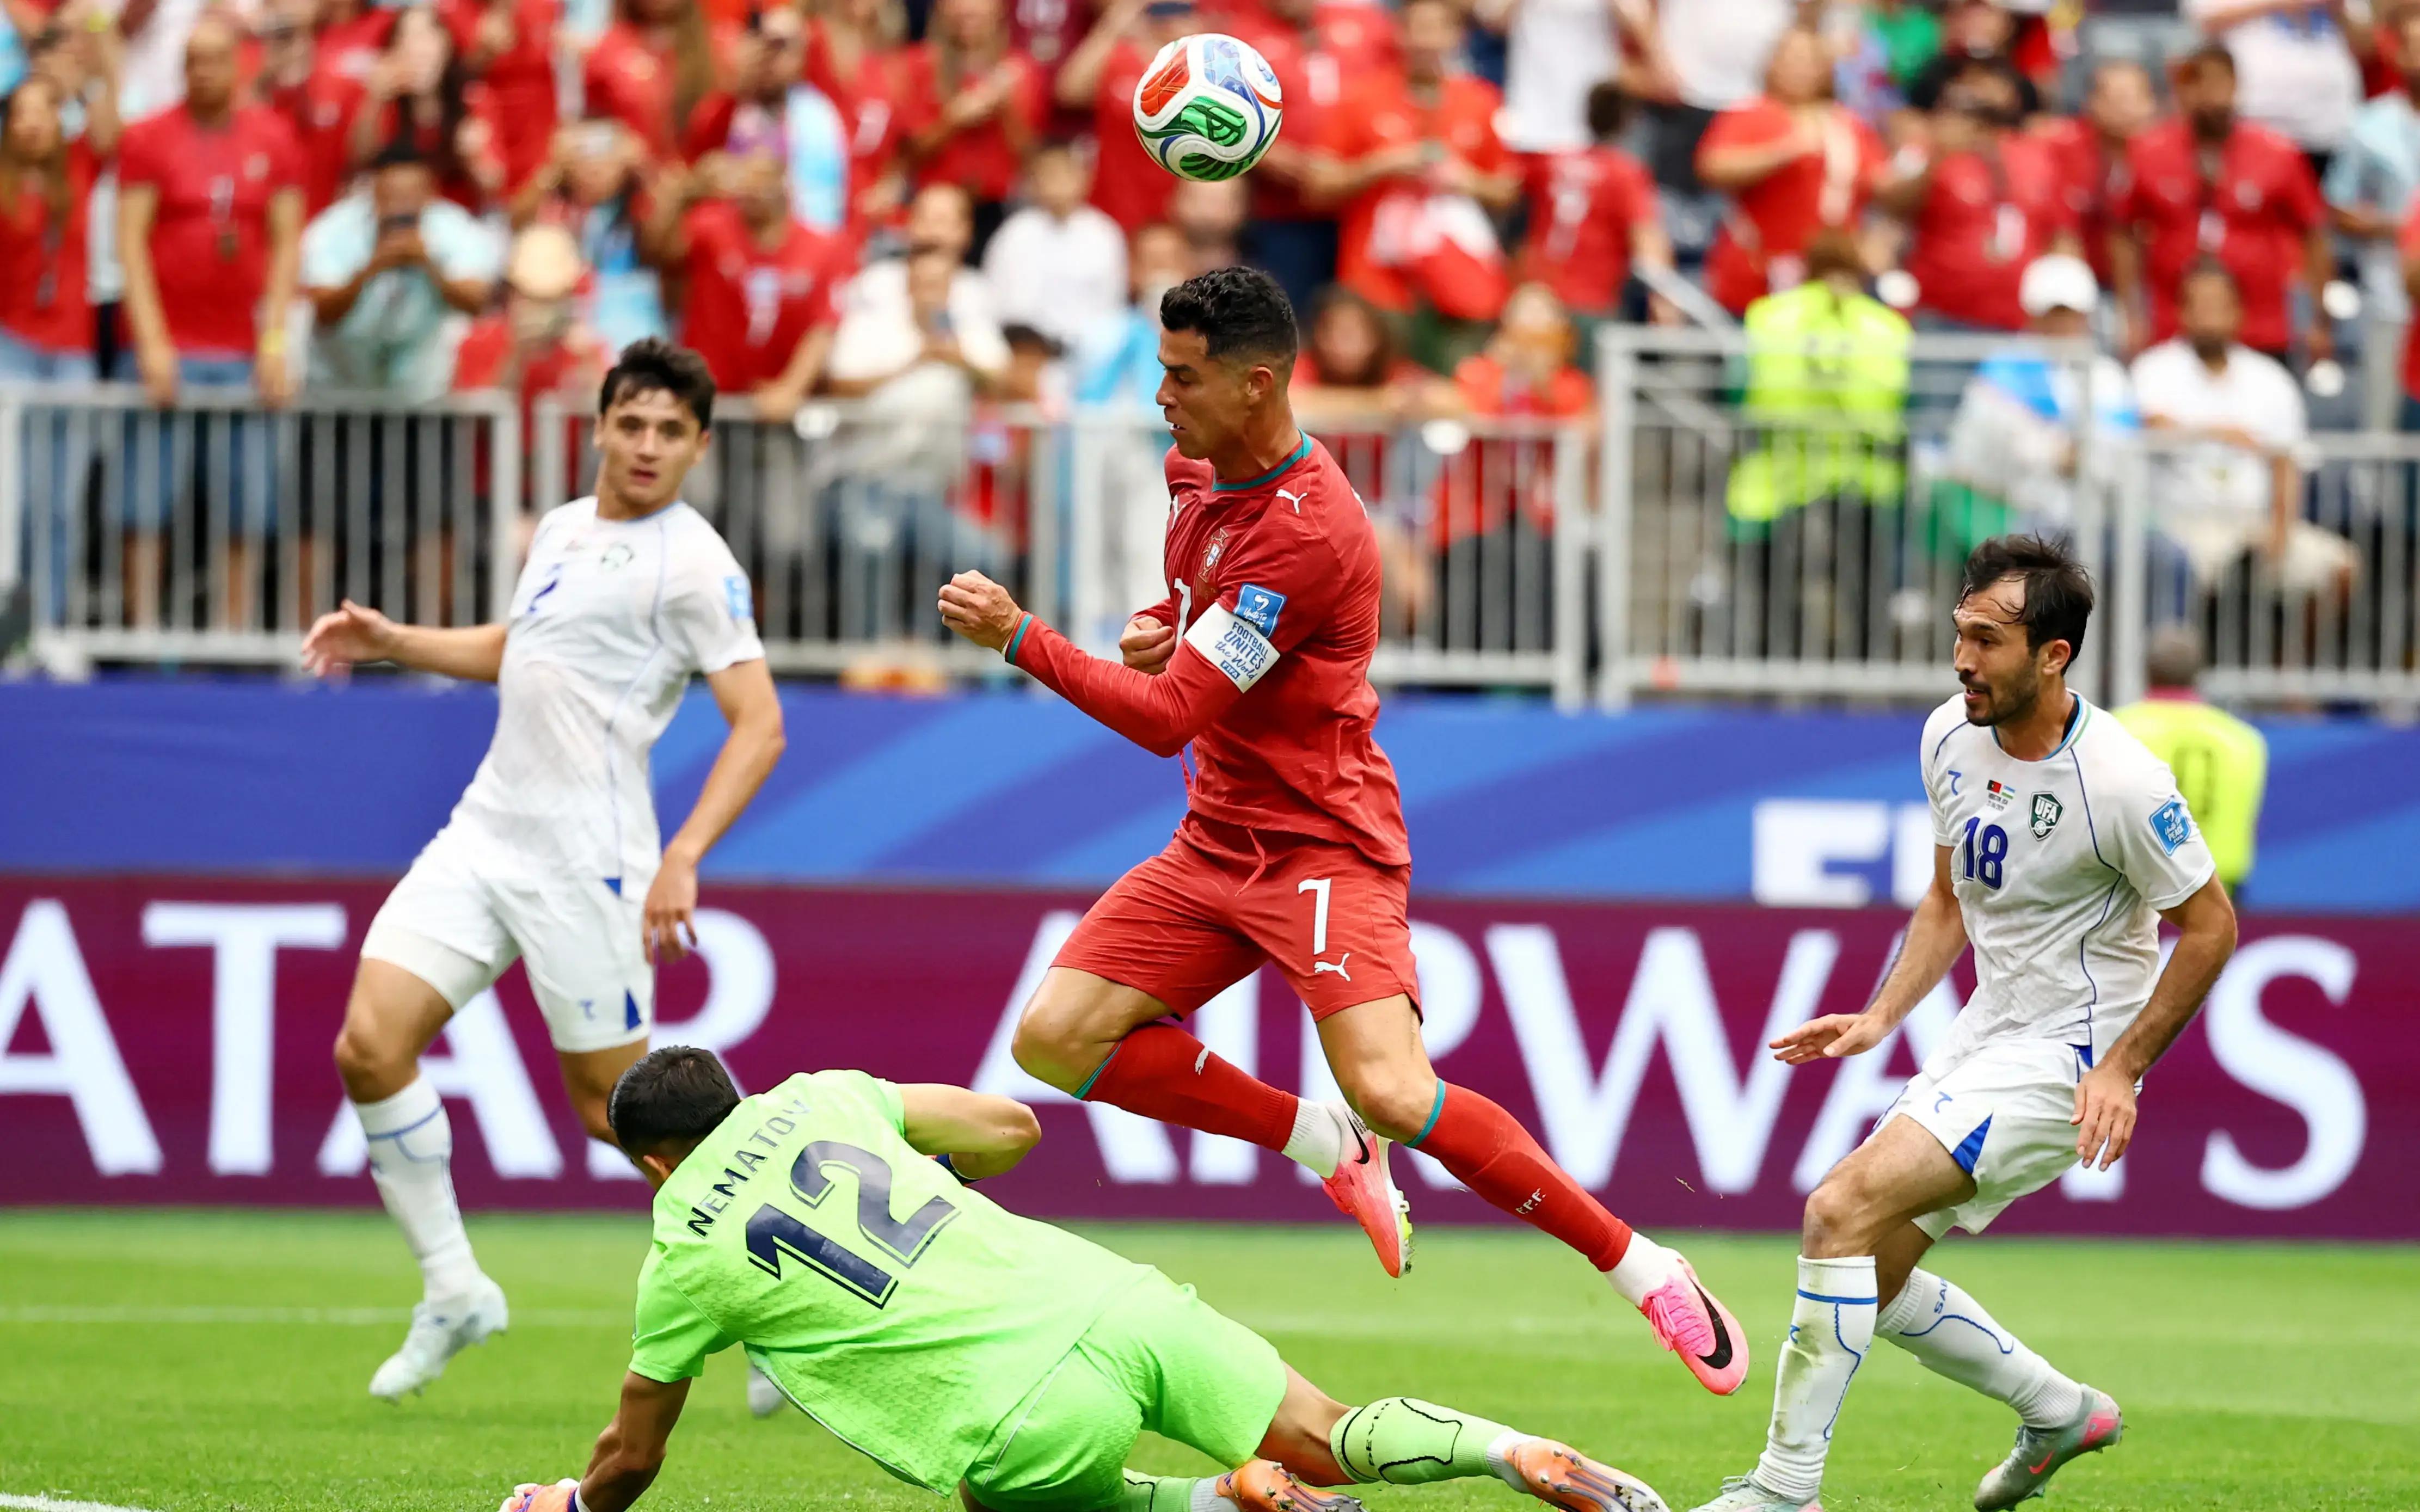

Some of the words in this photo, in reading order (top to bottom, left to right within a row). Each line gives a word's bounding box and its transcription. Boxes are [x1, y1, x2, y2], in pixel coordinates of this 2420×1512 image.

[1215, 640, 1233, 657] the
[1231, 654, 1258, 681] World
[1224, 630, 1264, 670] UNITES
[1232, 621, 1269, 660] FOOTBALL
[1221, 662, 1239, 678] FIFA
[2035, 797, 2058, 823] UFA
[1962, 816, 2009, 890] 18
[1298, 877, 1332, 955] 7
[686, 1098, 813, 1240] NEMATOV
[745, 1140, 962, 1310] 12
